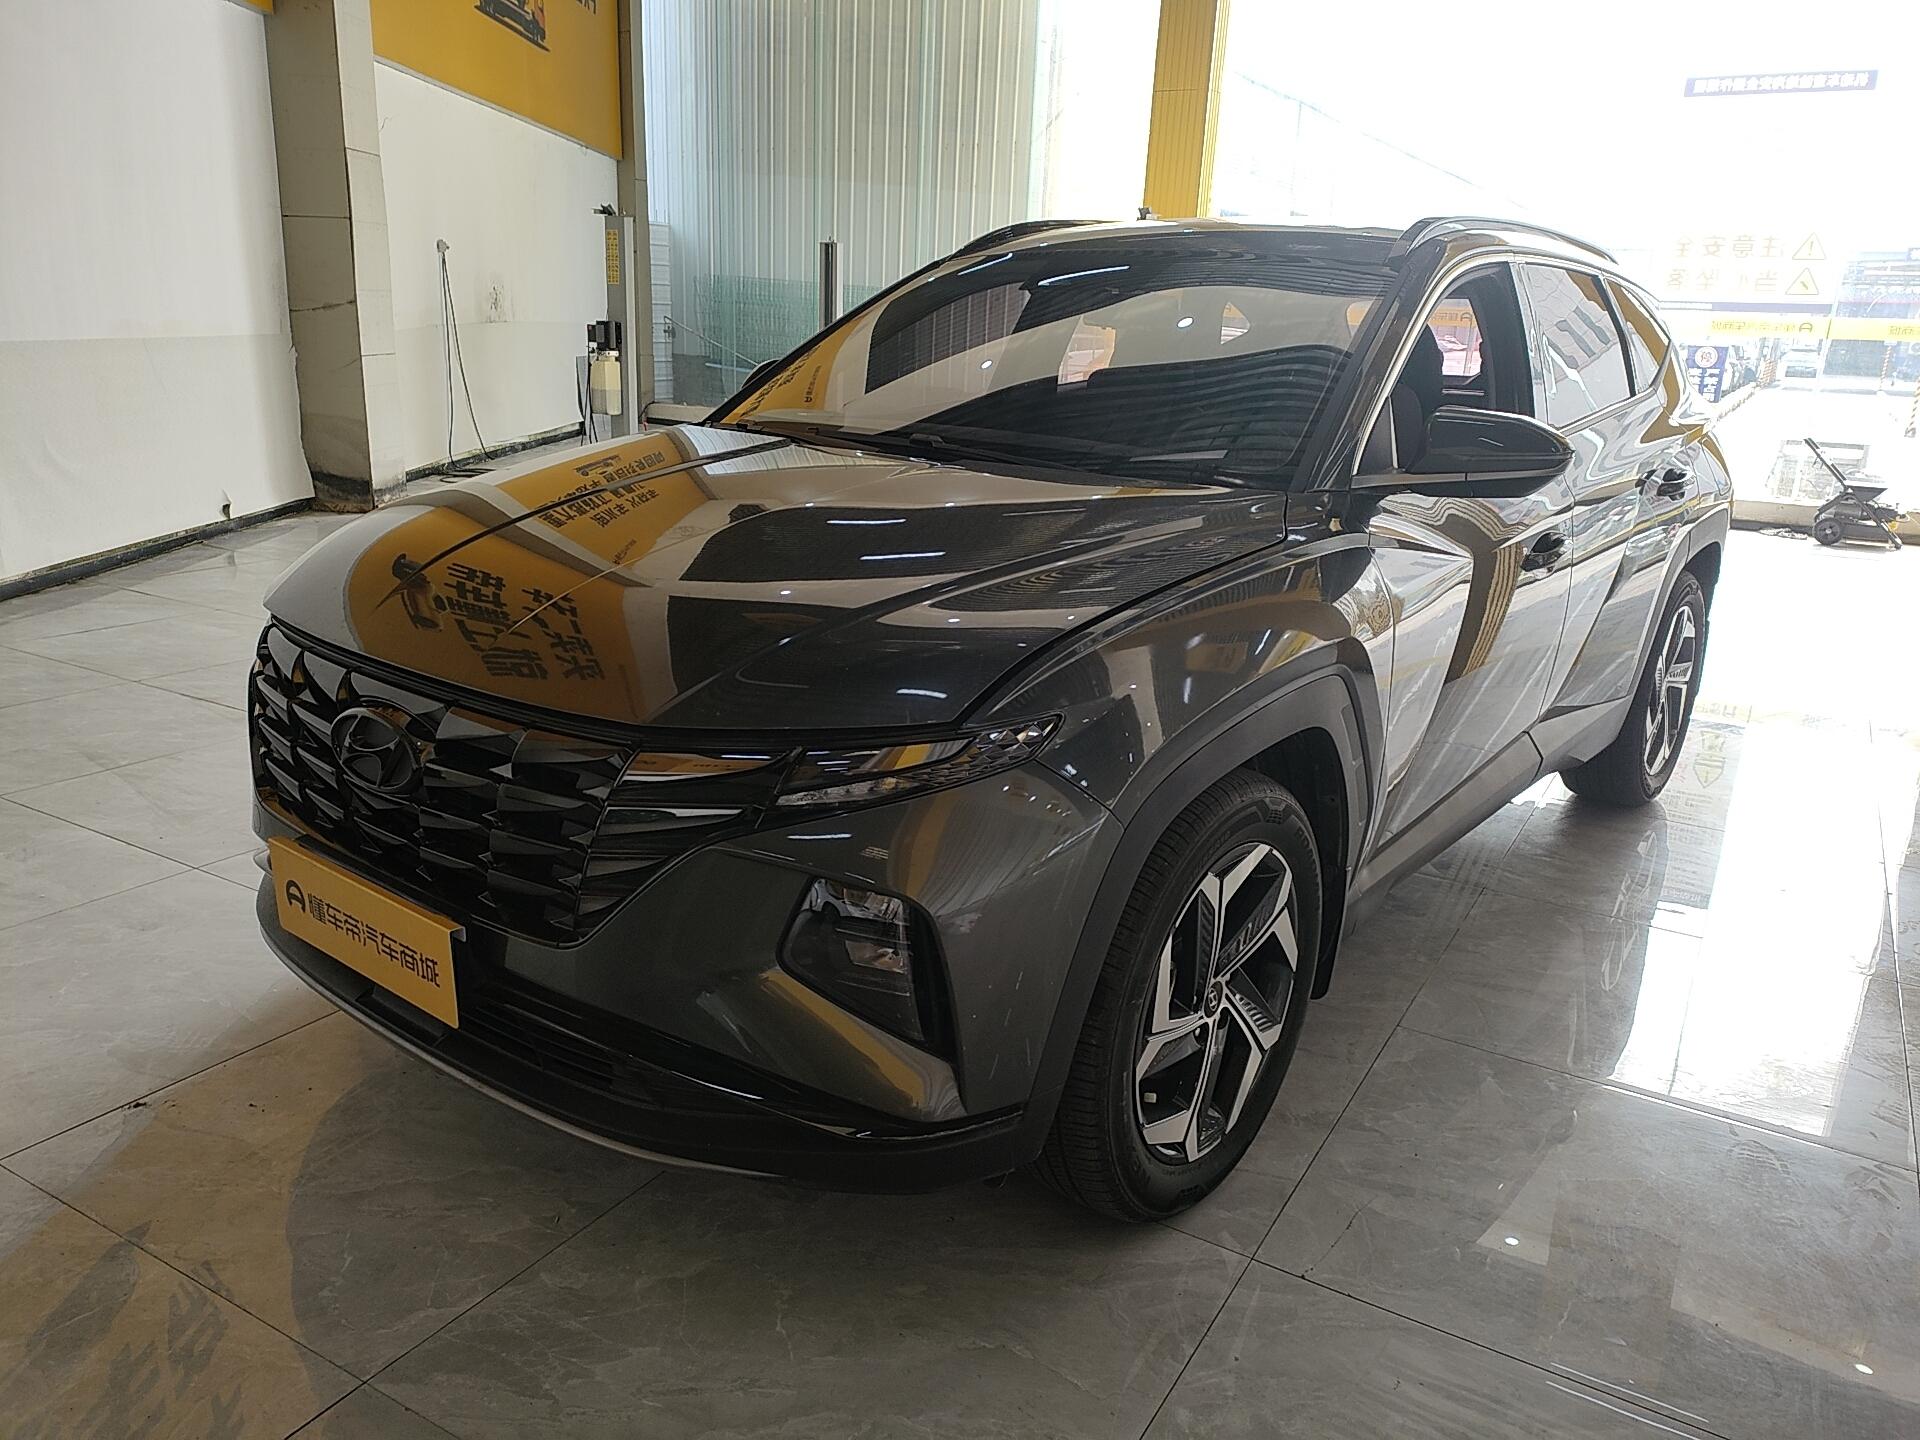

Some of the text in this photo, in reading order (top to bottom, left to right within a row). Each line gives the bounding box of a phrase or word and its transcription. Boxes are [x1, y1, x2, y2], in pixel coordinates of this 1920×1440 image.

[307, 892, 441, 988] 懂车帝汽车商城
